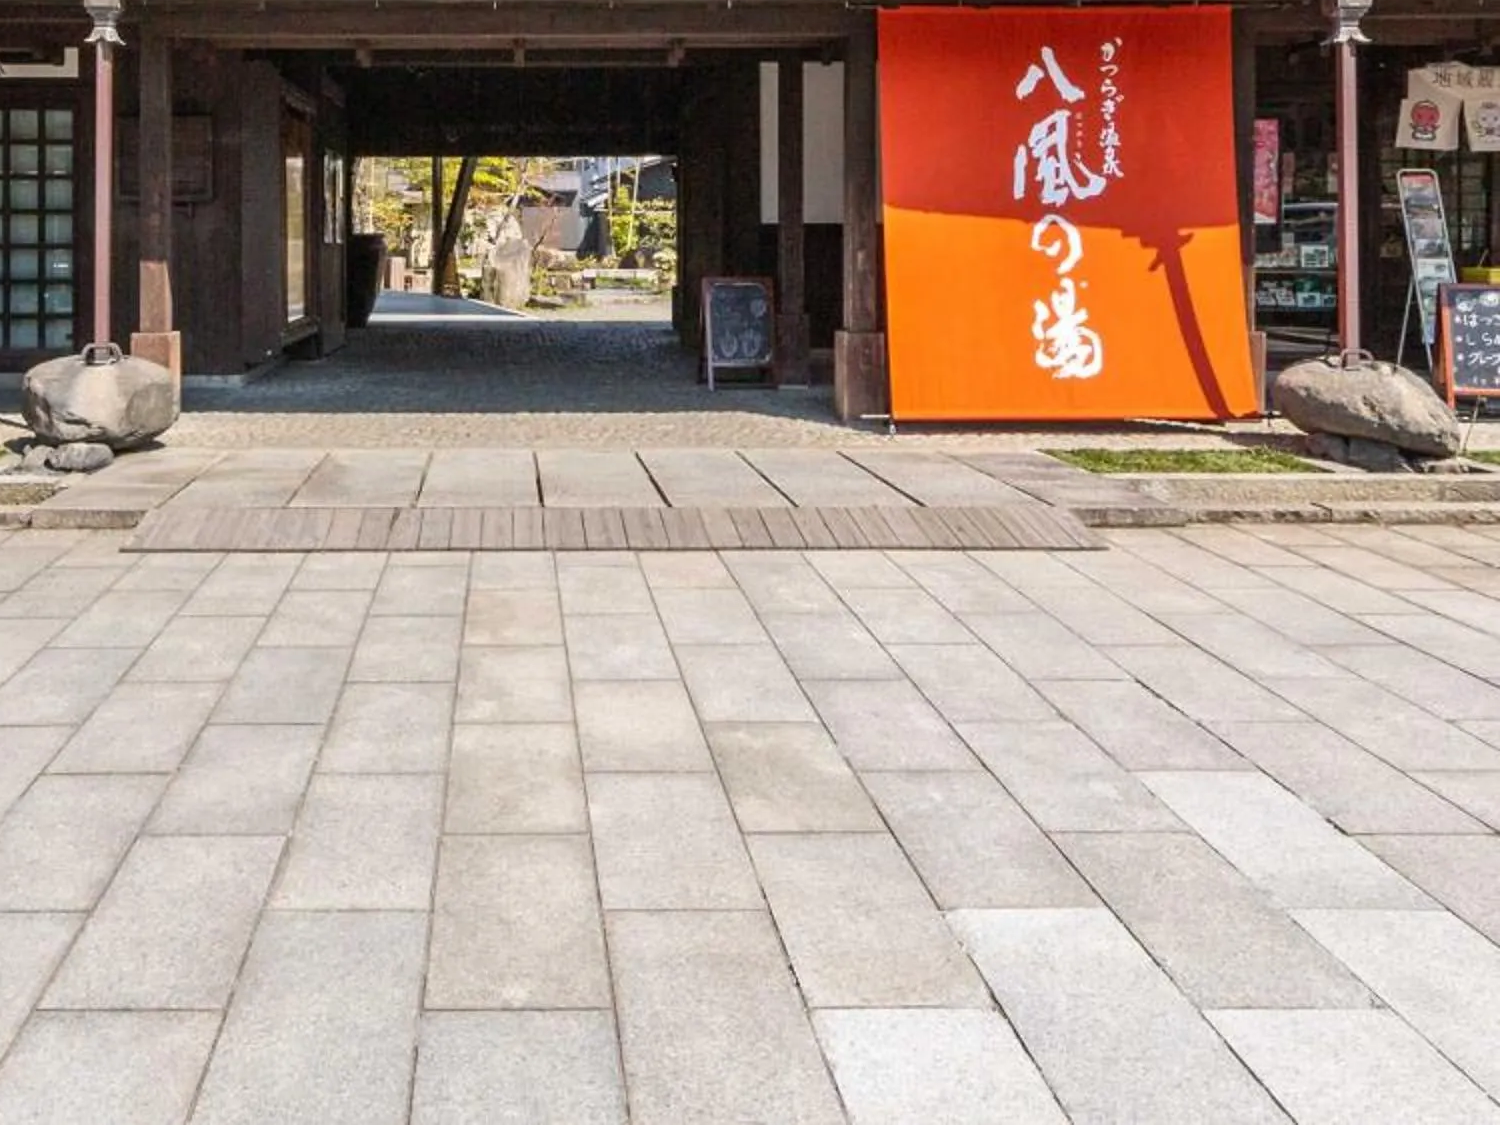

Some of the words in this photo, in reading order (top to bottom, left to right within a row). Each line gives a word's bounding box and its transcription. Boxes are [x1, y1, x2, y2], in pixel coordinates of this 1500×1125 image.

[1013, 46, 1106, 378] 八風の湯
[1100, 37, 1125, 177] かつらぎ温泉
